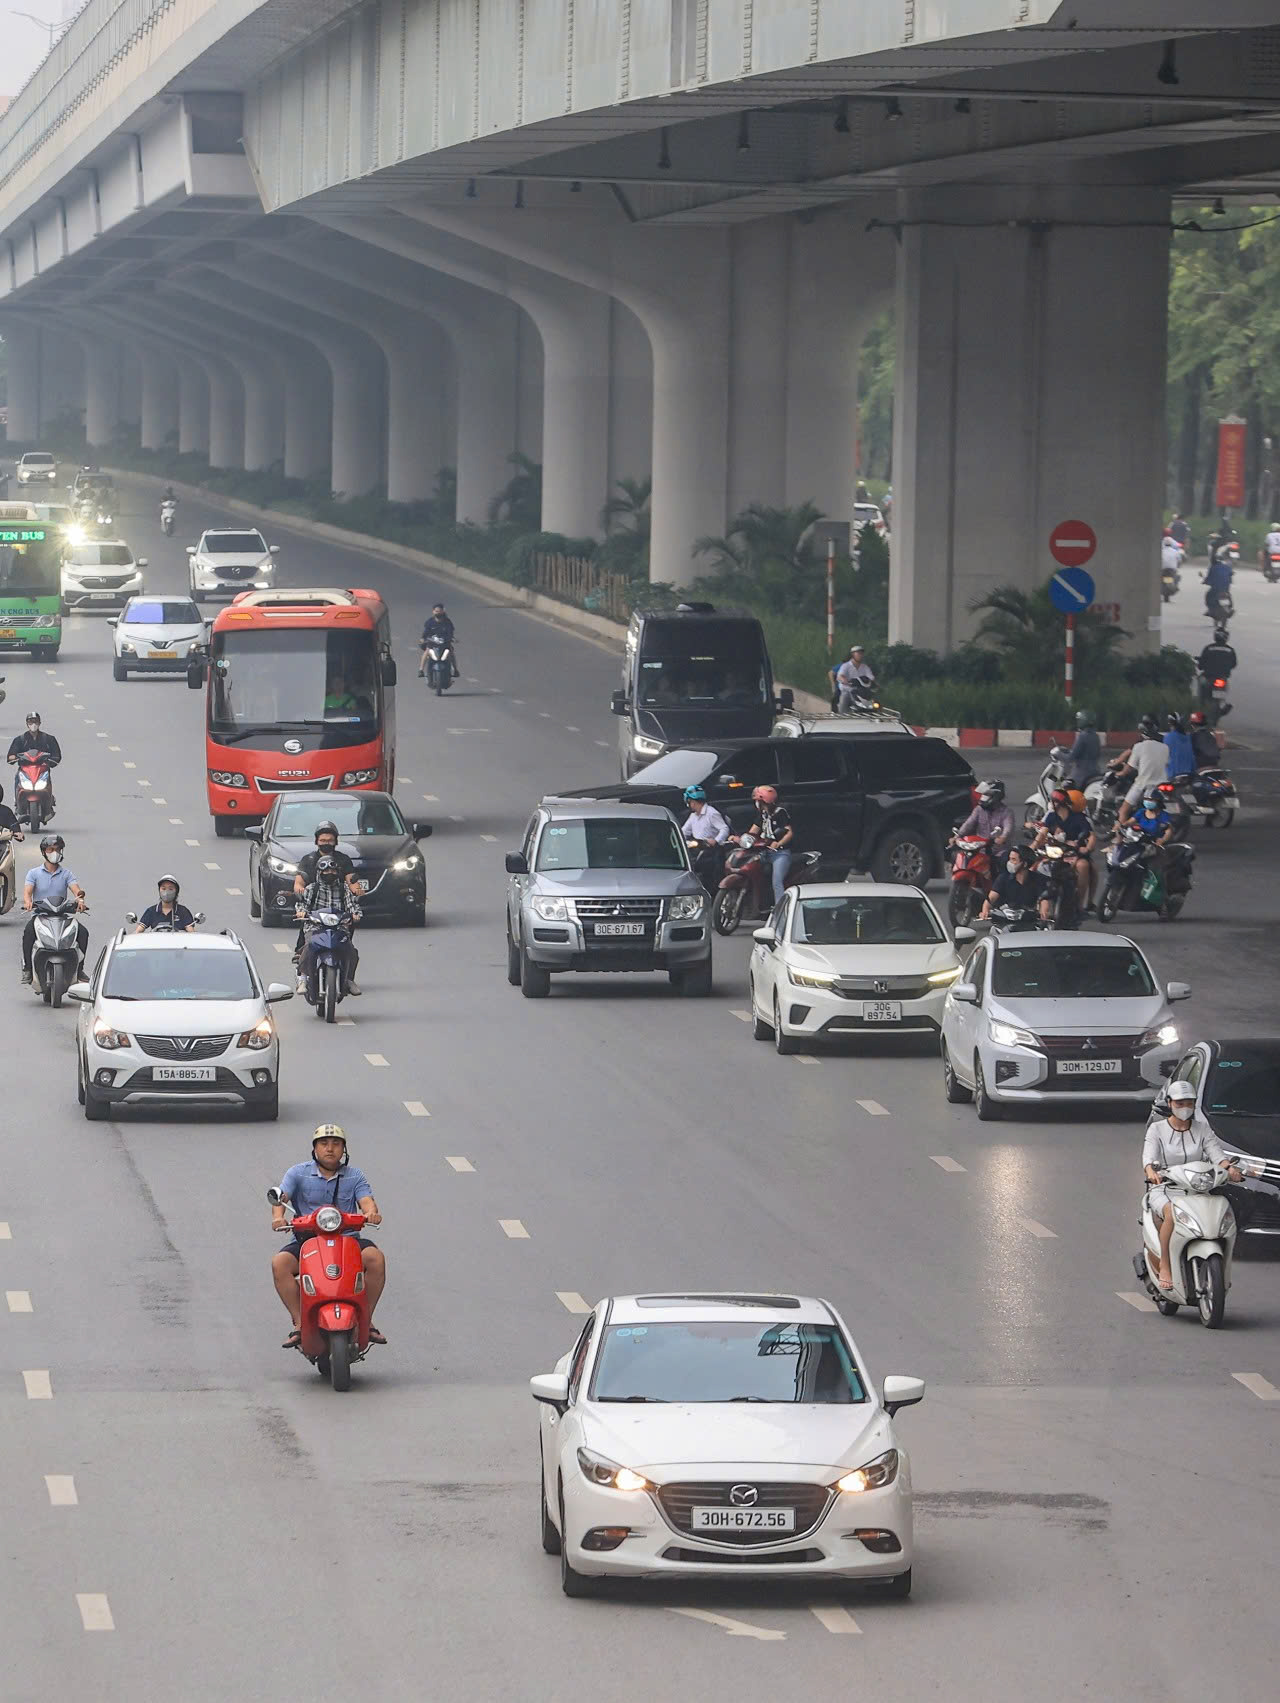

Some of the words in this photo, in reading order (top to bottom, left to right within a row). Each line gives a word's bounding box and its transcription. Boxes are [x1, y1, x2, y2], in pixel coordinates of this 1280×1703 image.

[21, 531, 45, 541] BUS
[874, 1002, 891, 1011] 30G
[867, 1011, 897, 1020] 897.54
[1062, 1061, 1117, 1072] 30M-129.07
[159, 1069, 211, 1079] 15A-885.71
[701, 1512, 786, 1527] 30H-672.56
